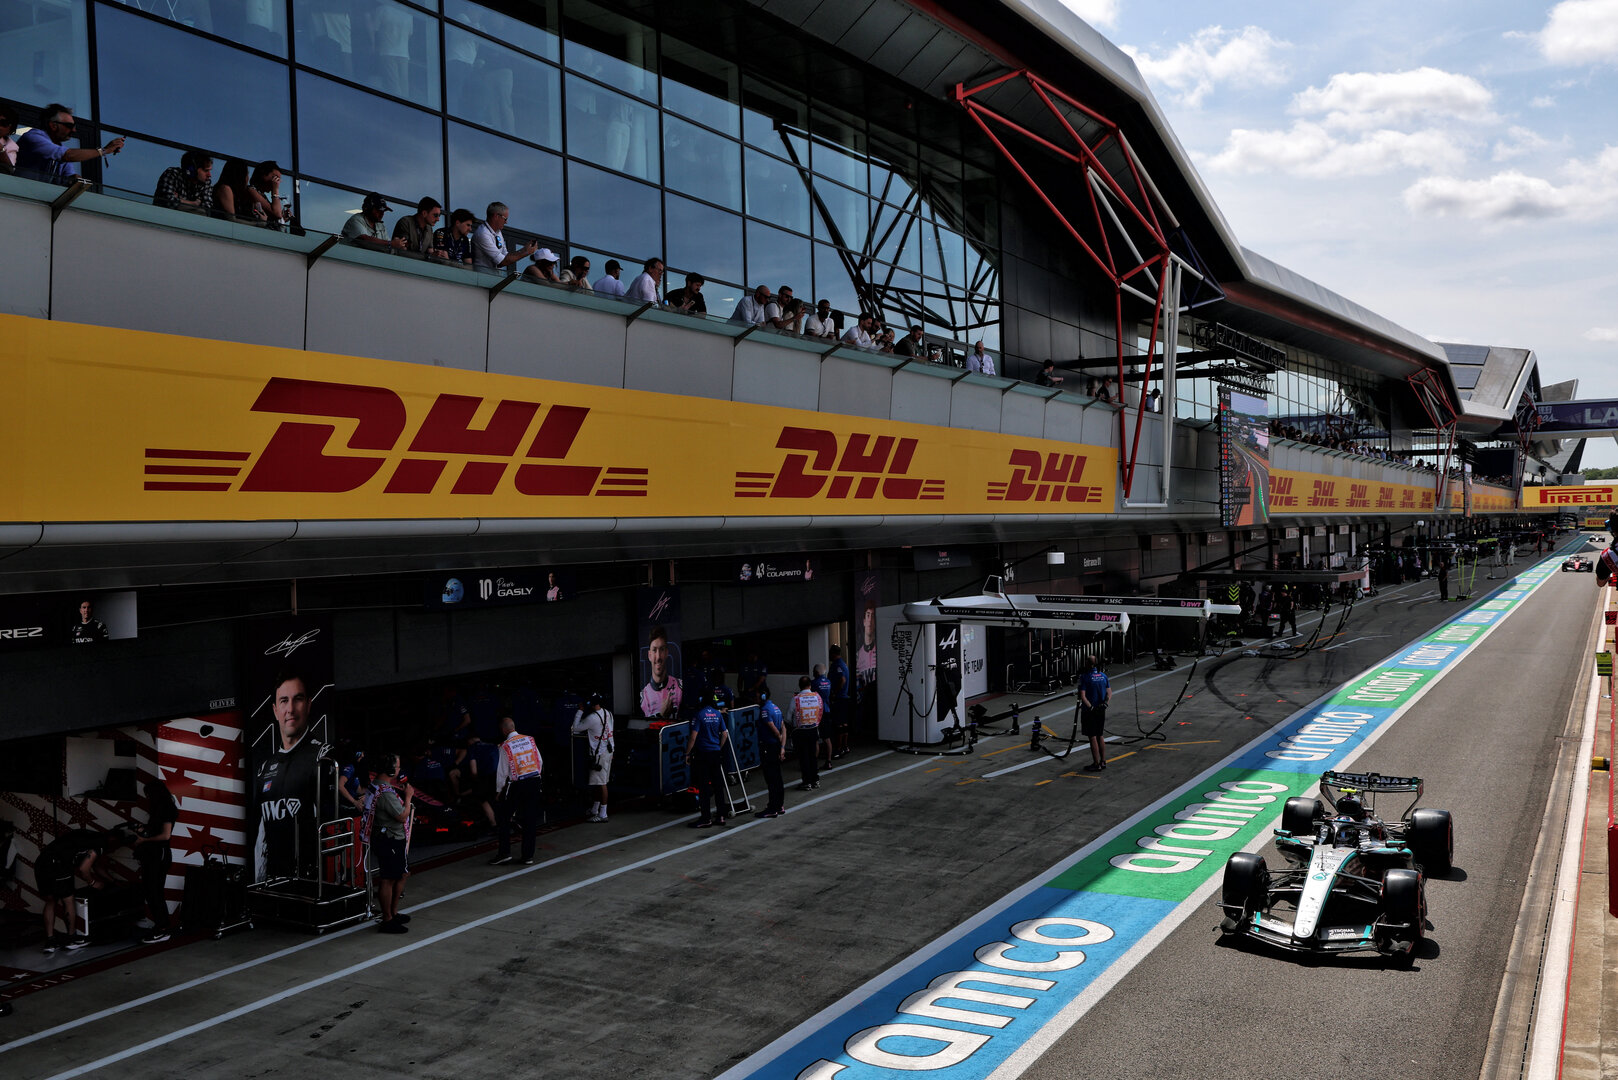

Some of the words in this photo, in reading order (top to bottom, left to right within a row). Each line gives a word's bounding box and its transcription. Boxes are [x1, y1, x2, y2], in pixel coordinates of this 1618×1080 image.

[237, 377, 602, 496] DHL
[769, 426, 924, 500] DHL
[1004, 448, 1087, 502] DHL
[1312, 479, 1335, 507] DHL
[1539, 488, 1613, 504] PIRELLI
[767, 570, 802, 578] COLAPINTO
[479, 579, 493, 600] 10
[497, 587, 534, 597] GASLY
[971, 659, 983, 673] TEAM
[1346, 671, 1424, 702] aramco
[209, 697, 236, 709] OLIVER
[1264, 711, 1375, 761] aramco
[1336, 773, 1410, 785] PETRONAS
[1109, 780, 1290, 874] aramco
